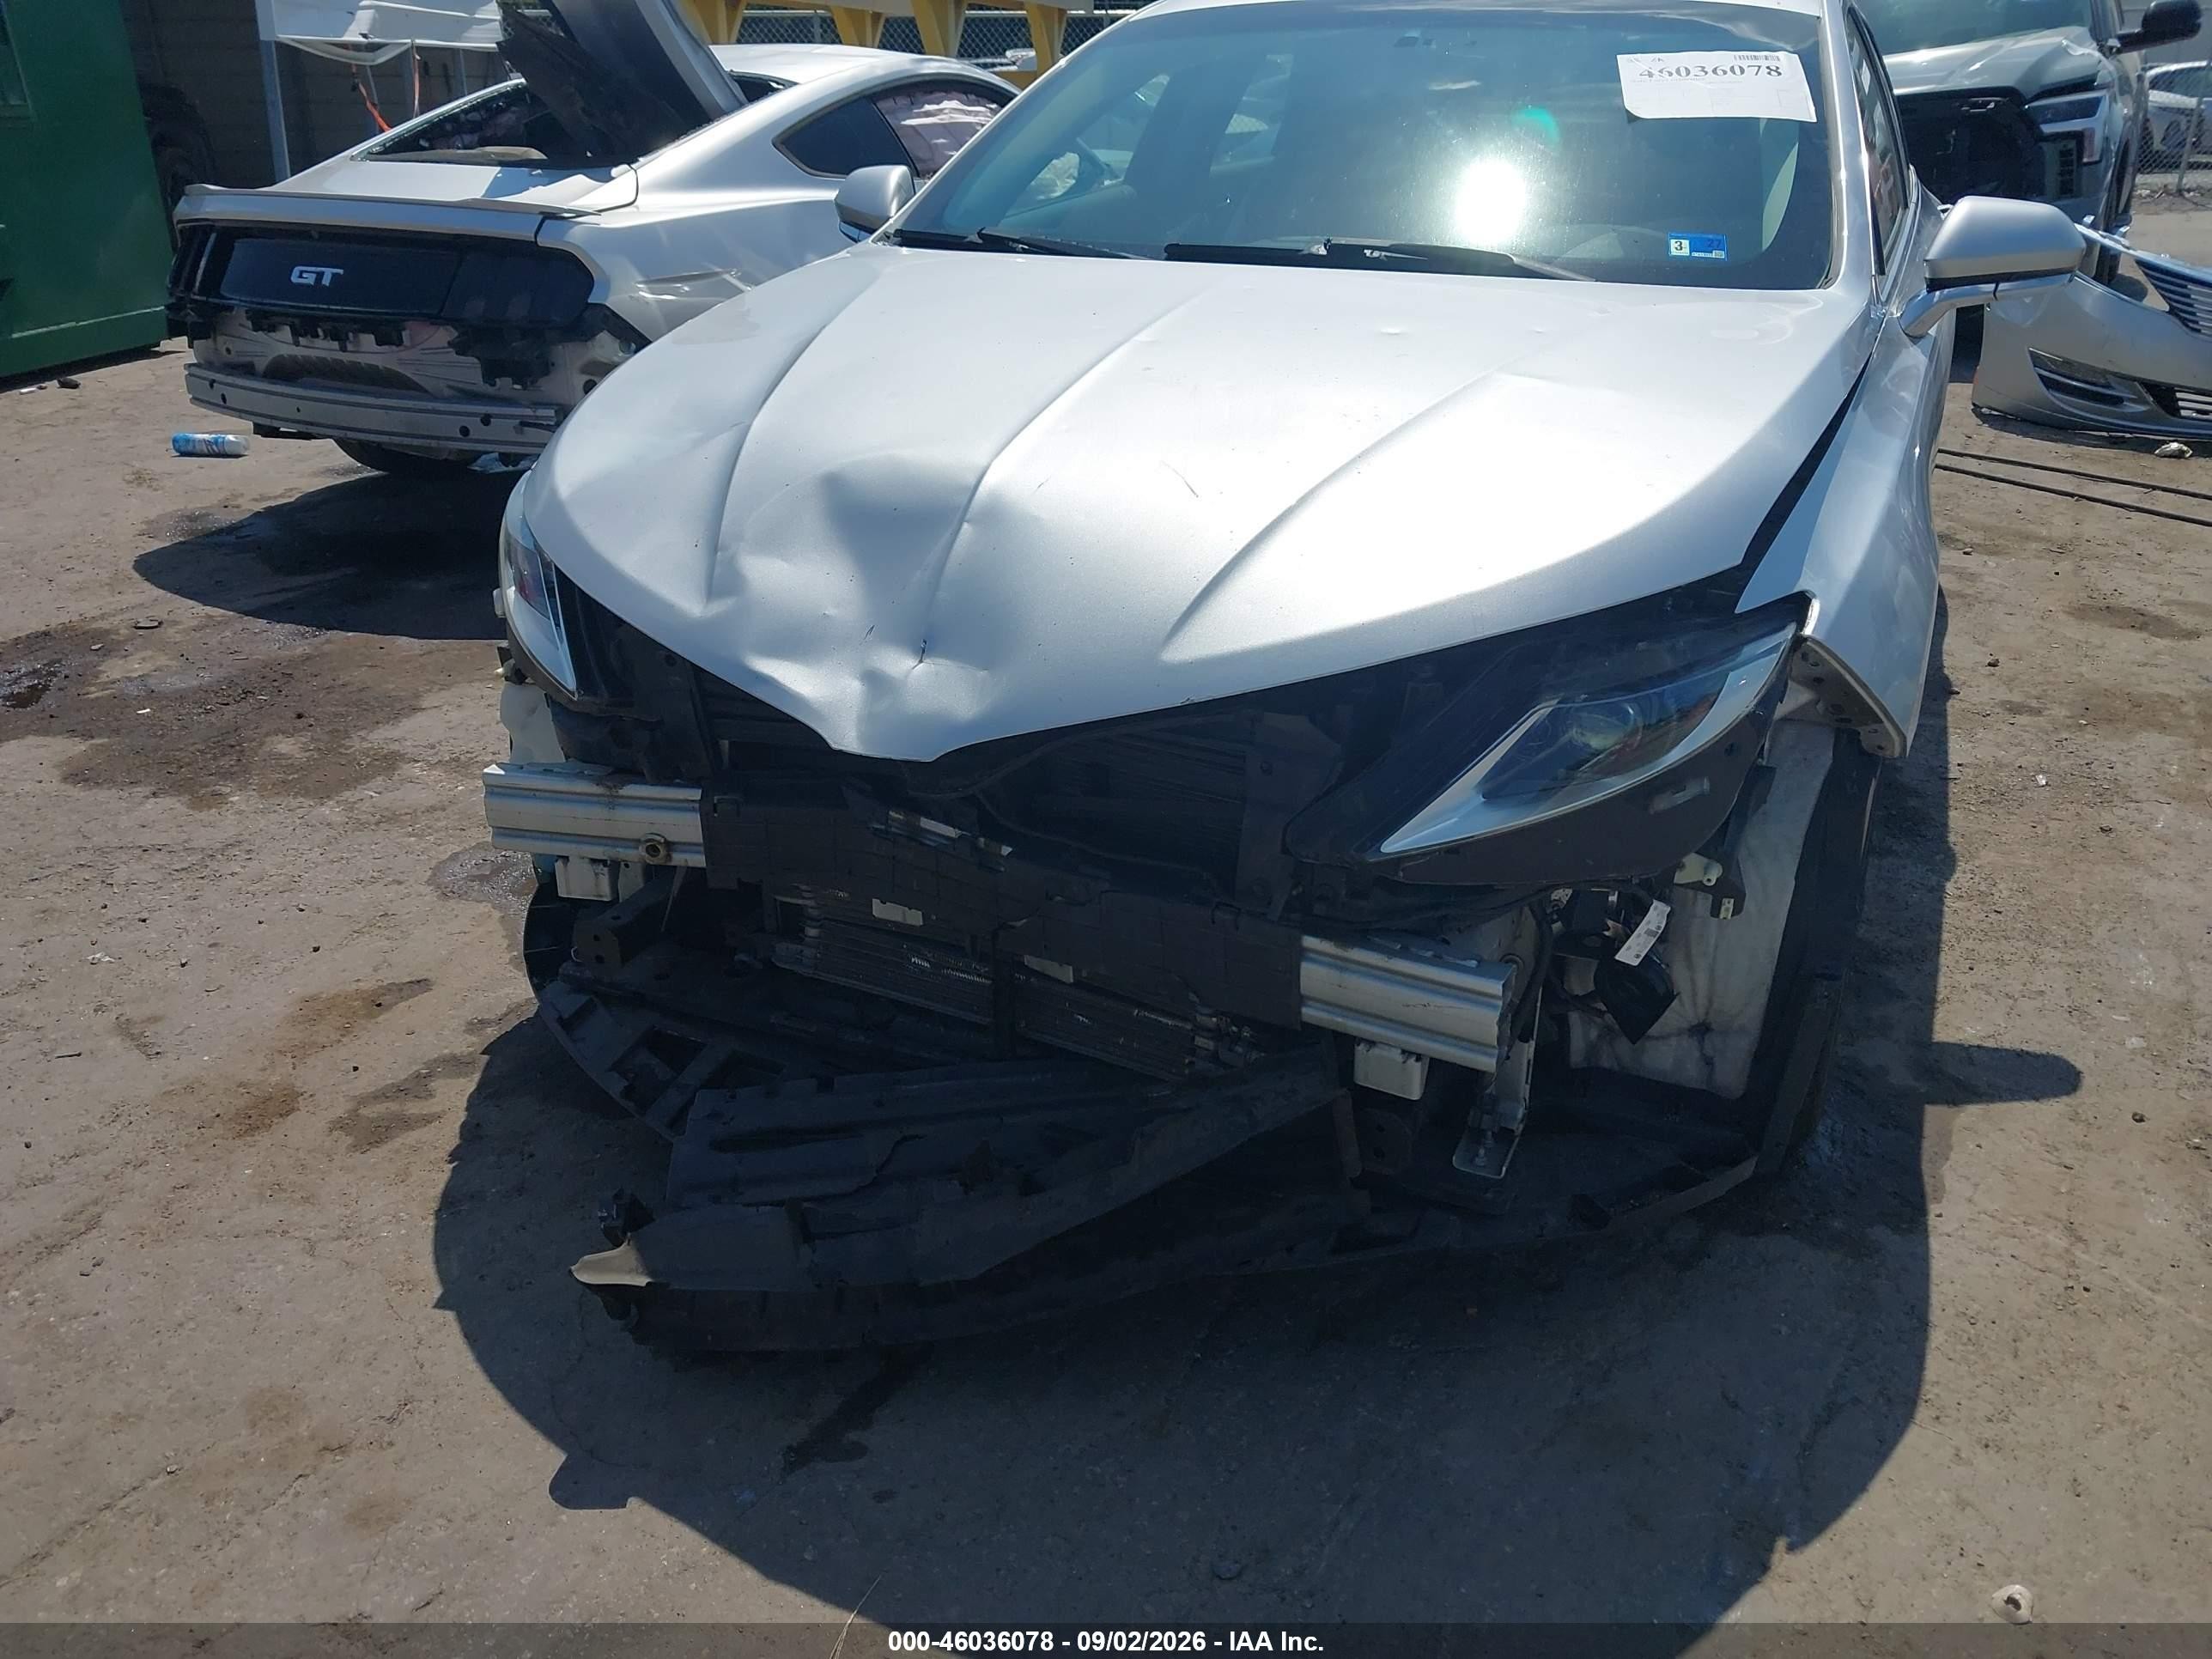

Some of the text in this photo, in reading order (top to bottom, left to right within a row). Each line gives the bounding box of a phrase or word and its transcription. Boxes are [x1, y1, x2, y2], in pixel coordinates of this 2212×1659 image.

[1638, 64, 1783, 78] 46036078
[1674, 240, 1683, 251] 3
[291, 265, 343, 286] GT
